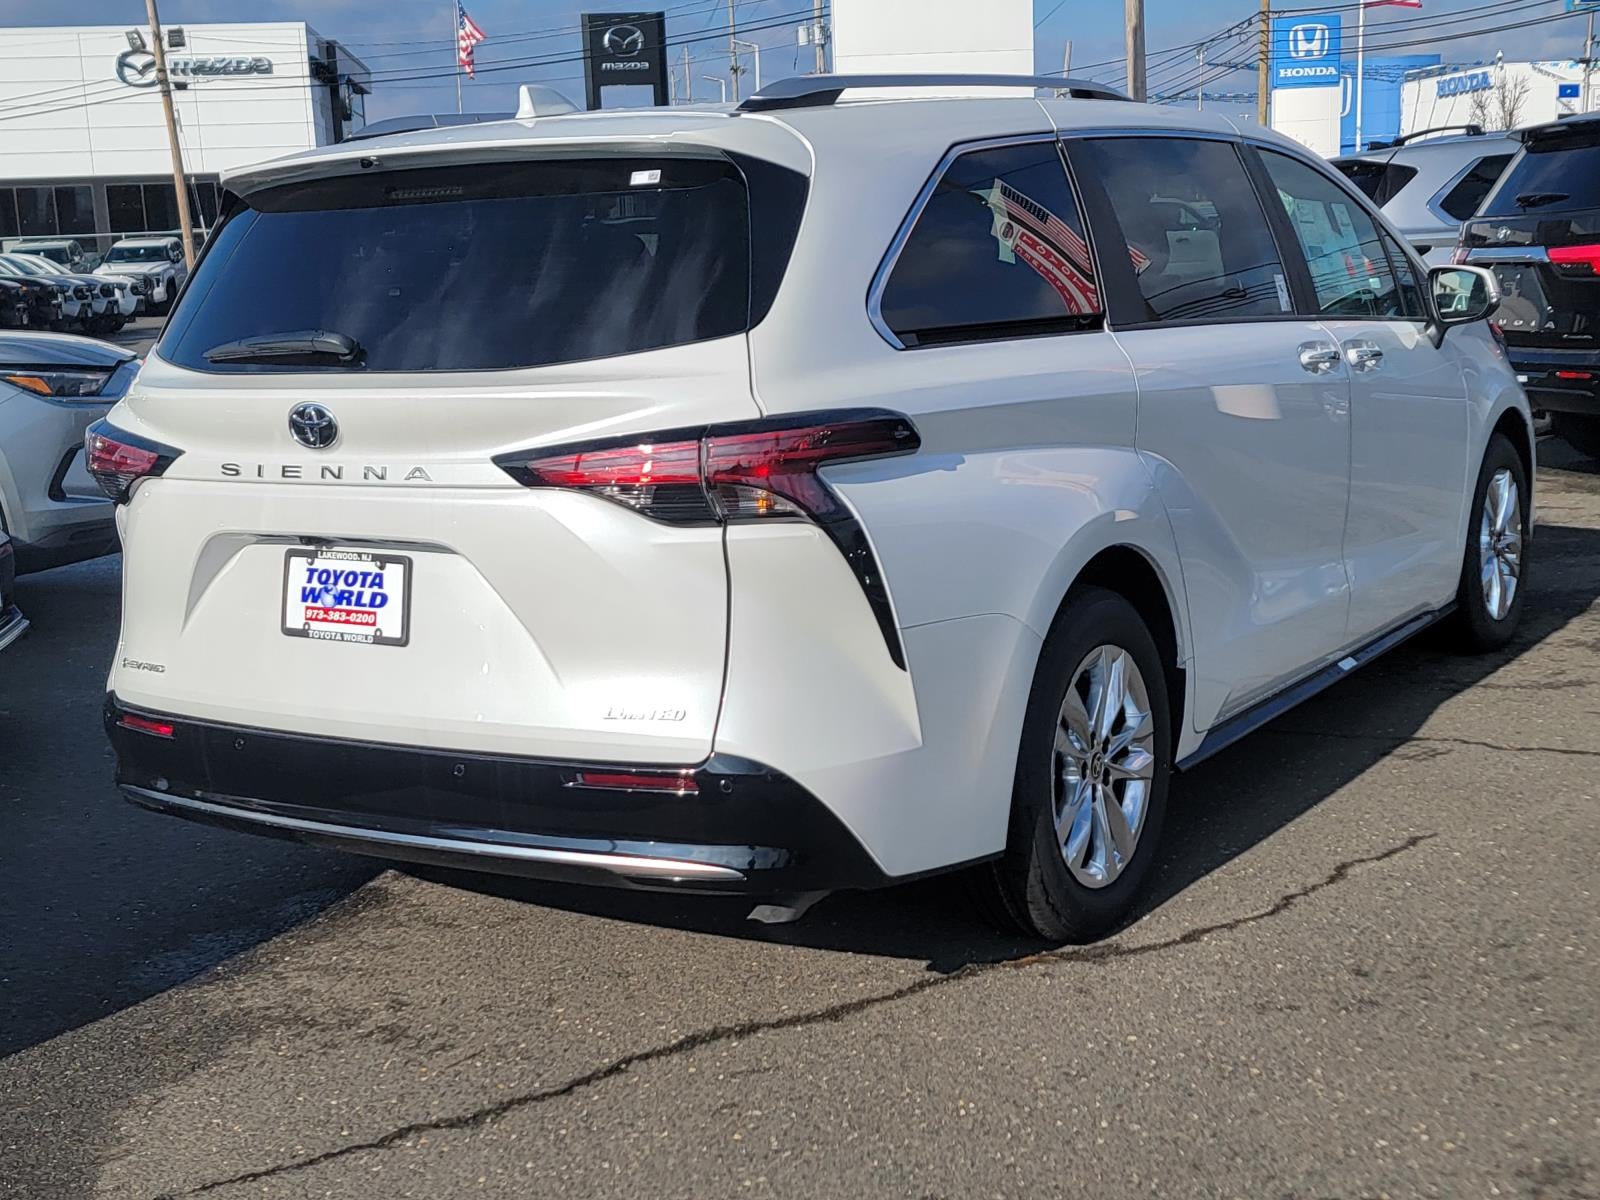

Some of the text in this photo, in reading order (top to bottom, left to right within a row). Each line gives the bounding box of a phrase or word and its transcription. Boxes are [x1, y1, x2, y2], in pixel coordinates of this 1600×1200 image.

[1279, 66, 1338, 78] HONDA
[1436, 71, 1491, 97] HONDA
[221, 463, 433, 482] SIENNA
[305, 567, 385, 589] TOYOTA
[300, 586, 389, 609] WORLD
[305, 609, 375, 624] 973-383-0200
[308, 630, 374, 644] TOYOTA WORLD
